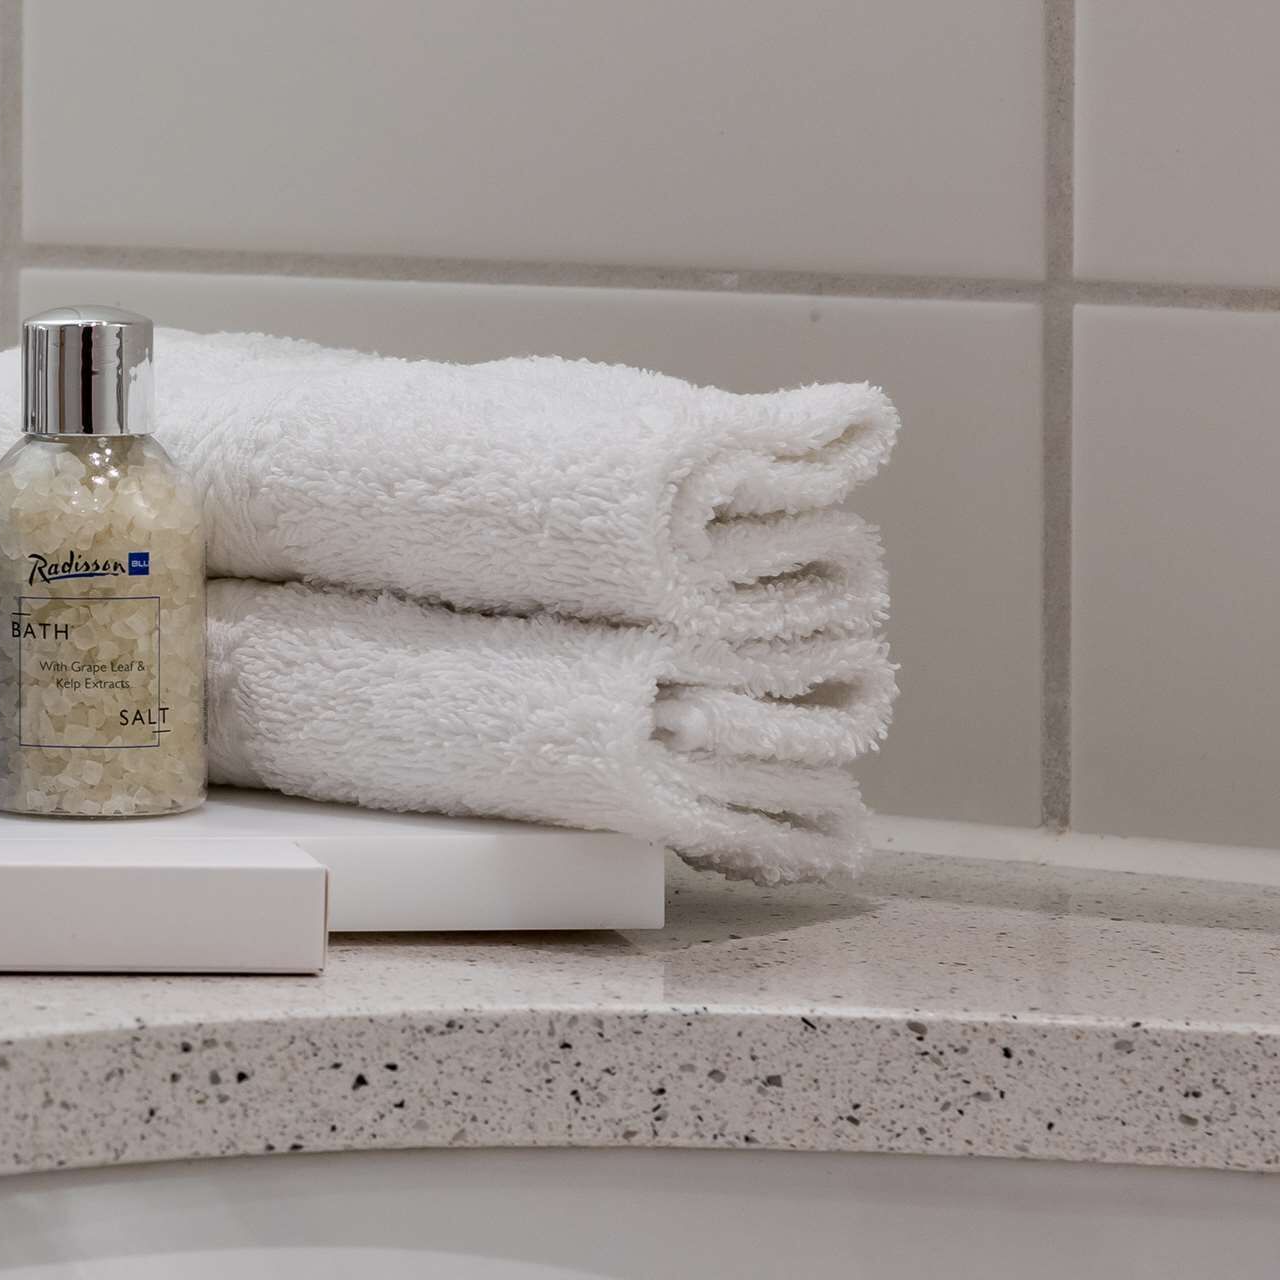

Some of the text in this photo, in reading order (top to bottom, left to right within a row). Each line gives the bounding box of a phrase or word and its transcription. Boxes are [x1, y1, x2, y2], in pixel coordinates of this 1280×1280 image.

[28, 550, 126, 586] Radisson
[11, 621, 69, 640] BATH
[40, 660, 145, 675] With Grape Leaf &
[56, 678, 130, 691] Kelp Extracts
[119, 707, 170, 726] SALT
